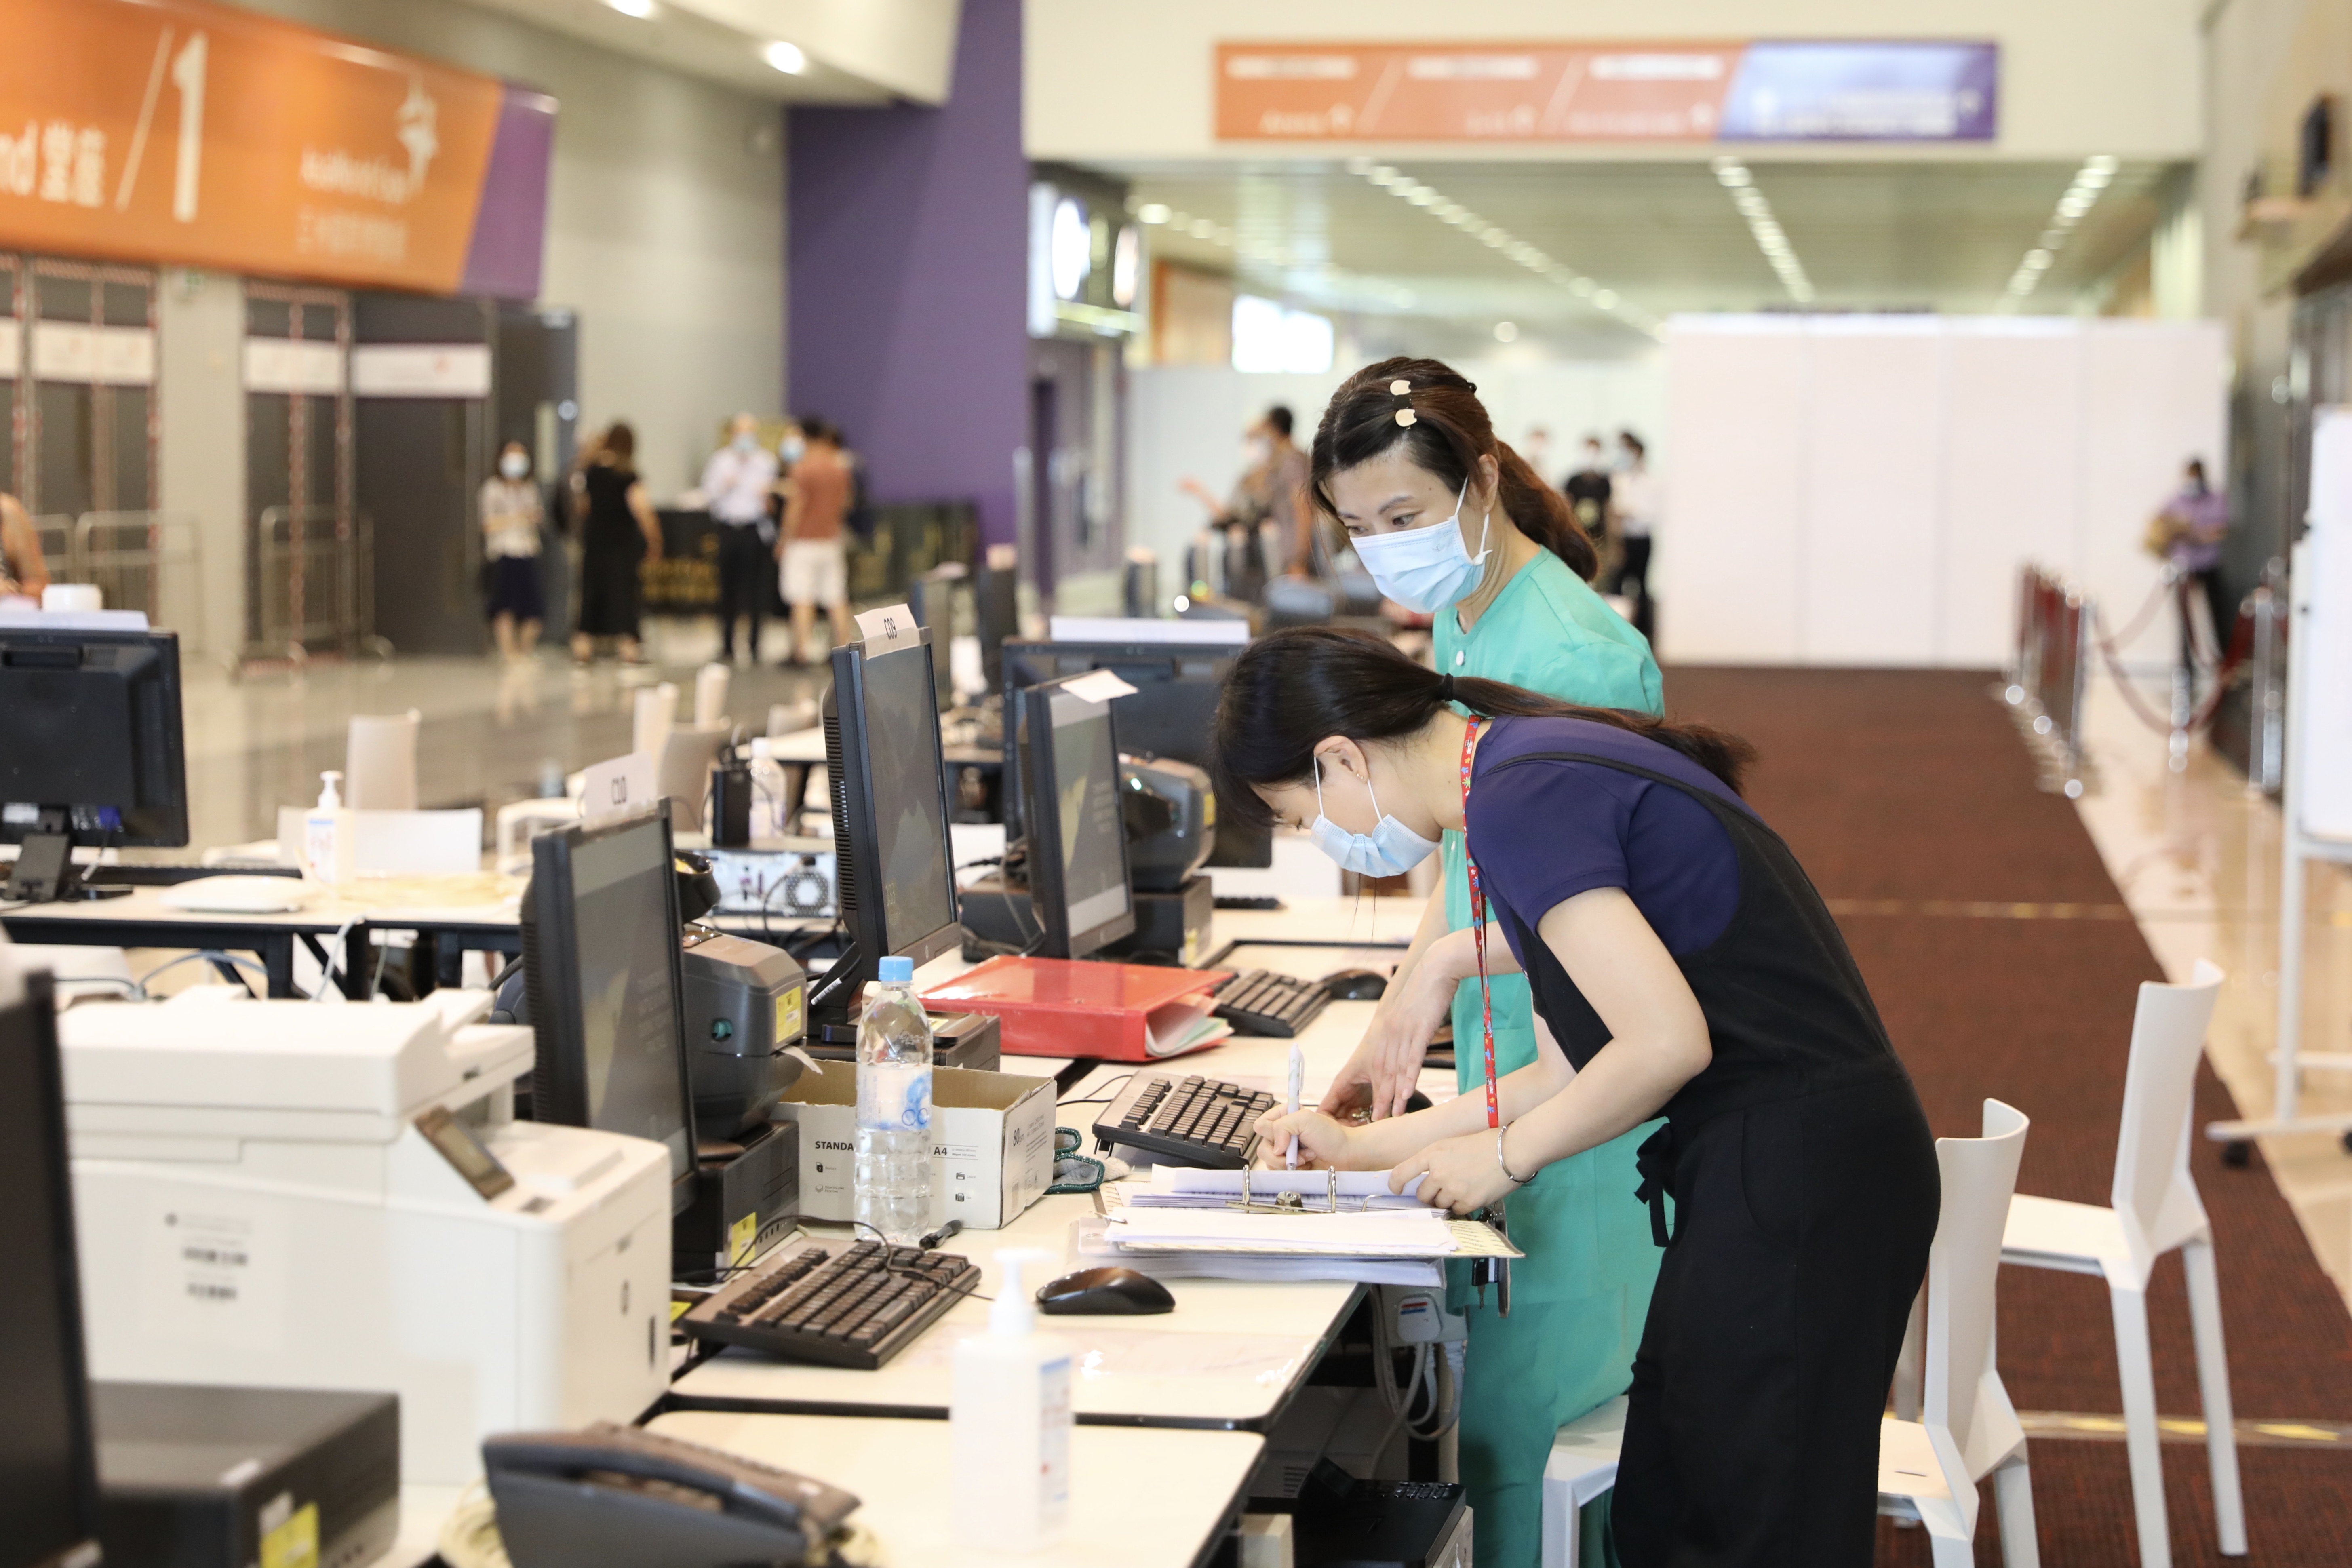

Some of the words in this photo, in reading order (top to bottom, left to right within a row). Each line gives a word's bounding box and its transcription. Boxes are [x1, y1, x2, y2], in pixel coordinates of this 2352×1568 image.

[884, 617, 897, 640] C09
[611, 775, 627, 805] C10
[815, 1141, 854, 1151] STANDA
[934, 1146, 948, 1156] A4
